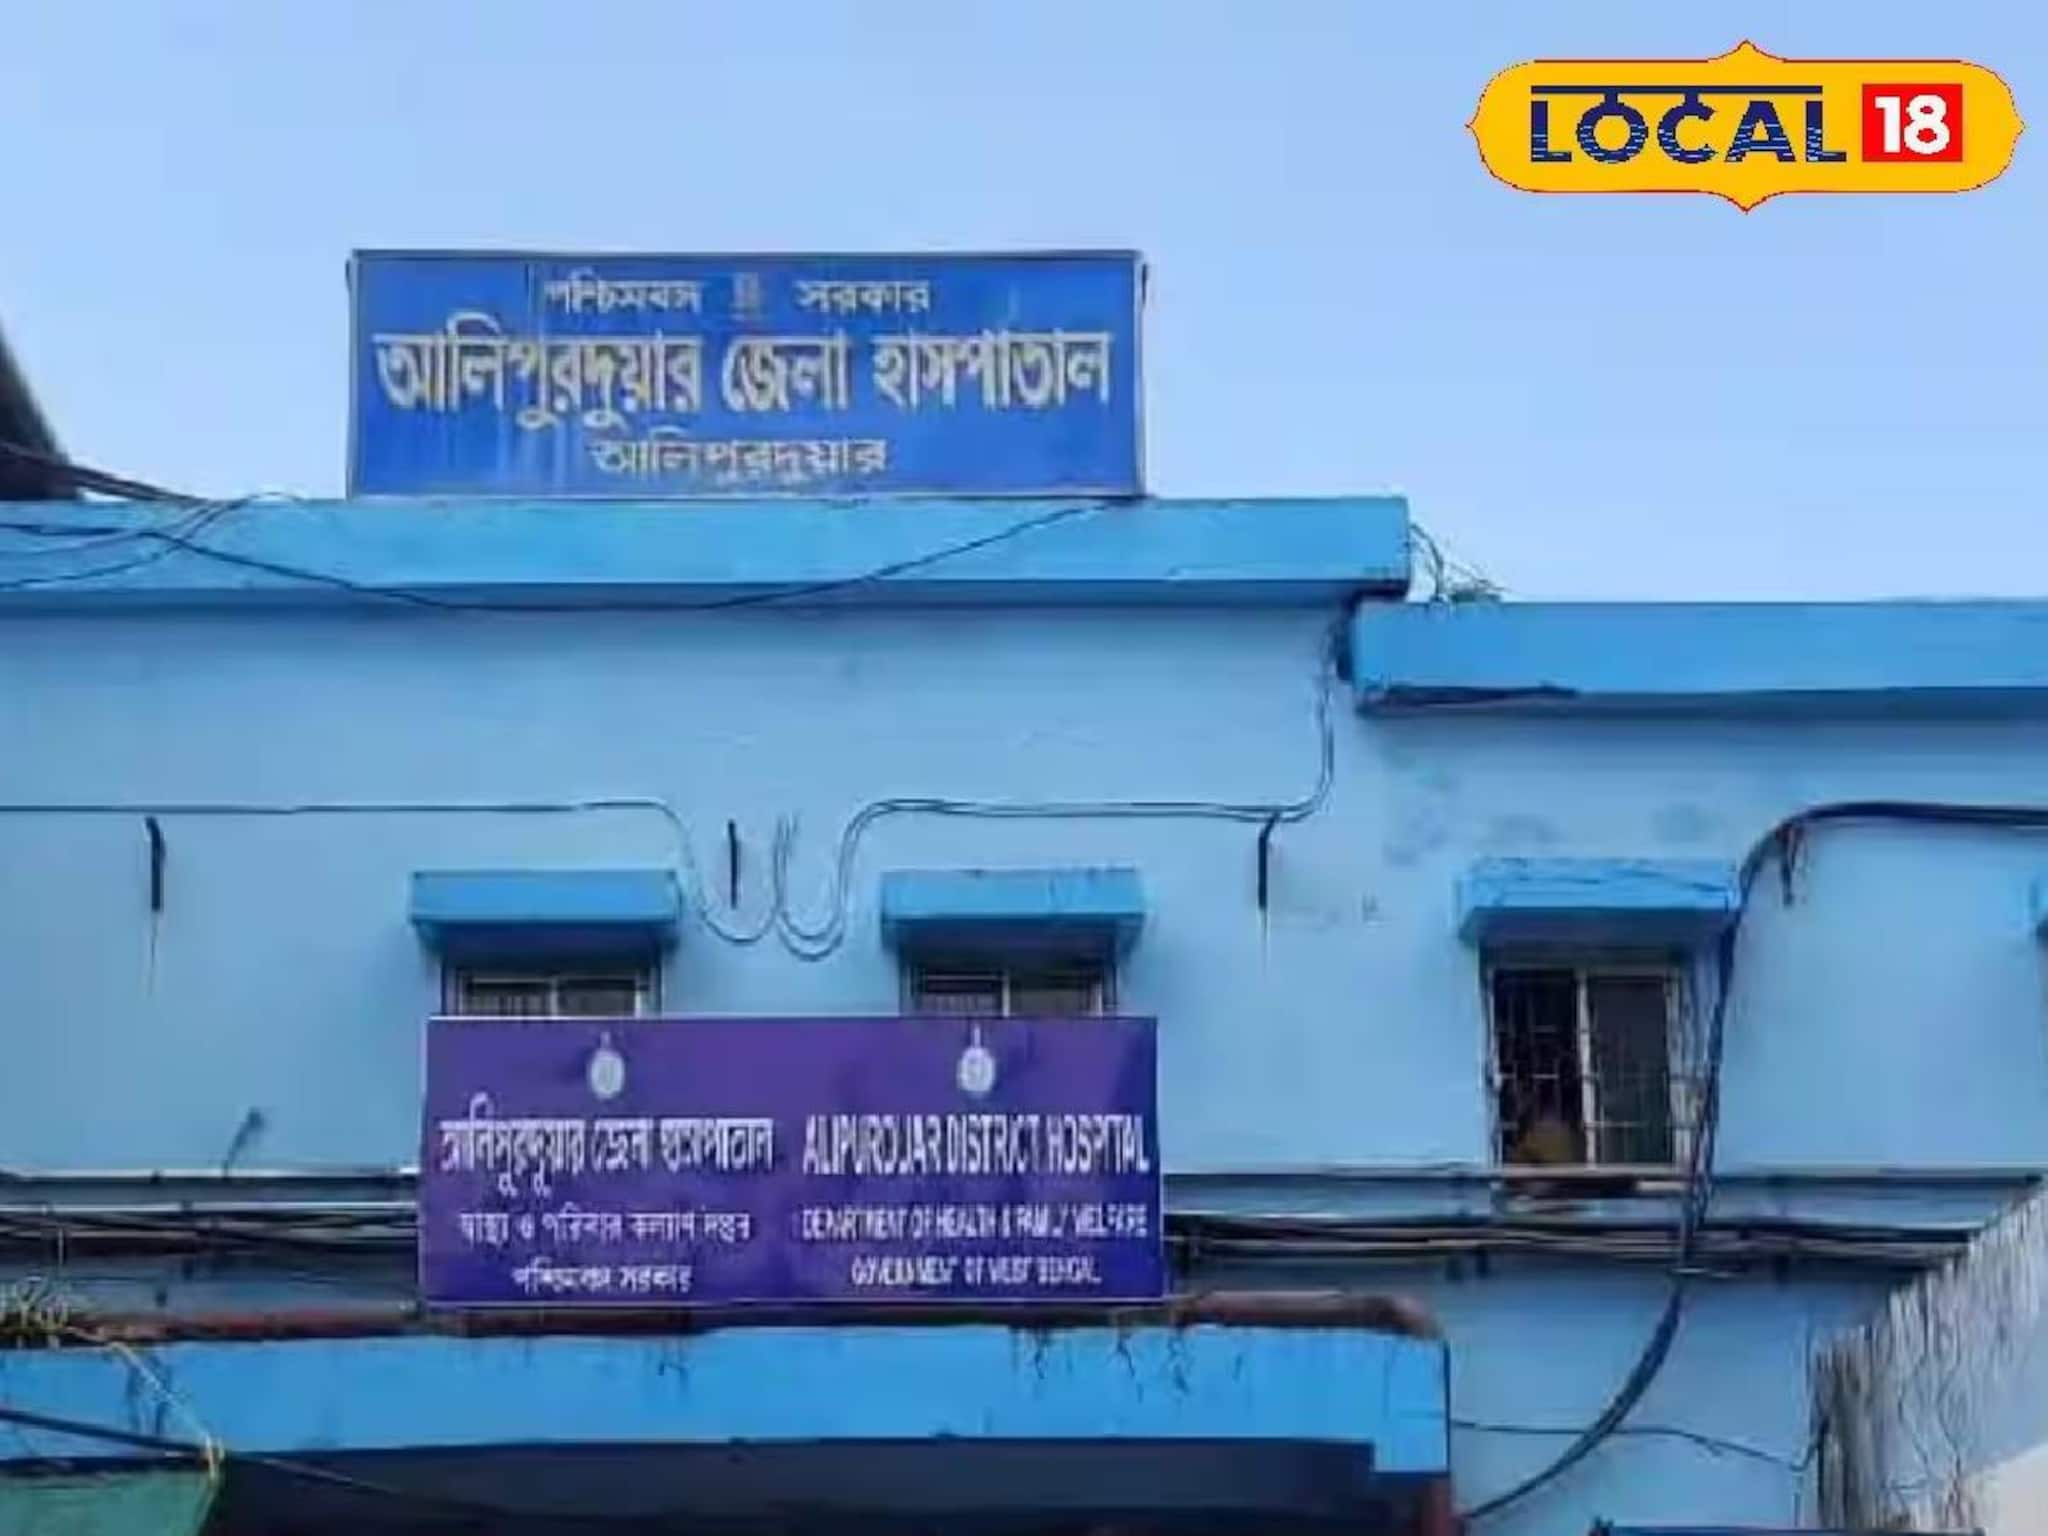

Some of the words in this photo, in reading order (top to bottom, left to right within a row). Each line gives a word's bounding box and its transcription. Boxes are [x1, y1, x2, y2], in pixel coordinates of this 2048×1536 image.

[373, 312, 704, 430] আলিপুরদুয়ার
[722, 330, 850, 411] জেলা
[871, 330, 1113, 409] হাসপাতাল
[946, 1115, 1039, 1174] DISTRICT
